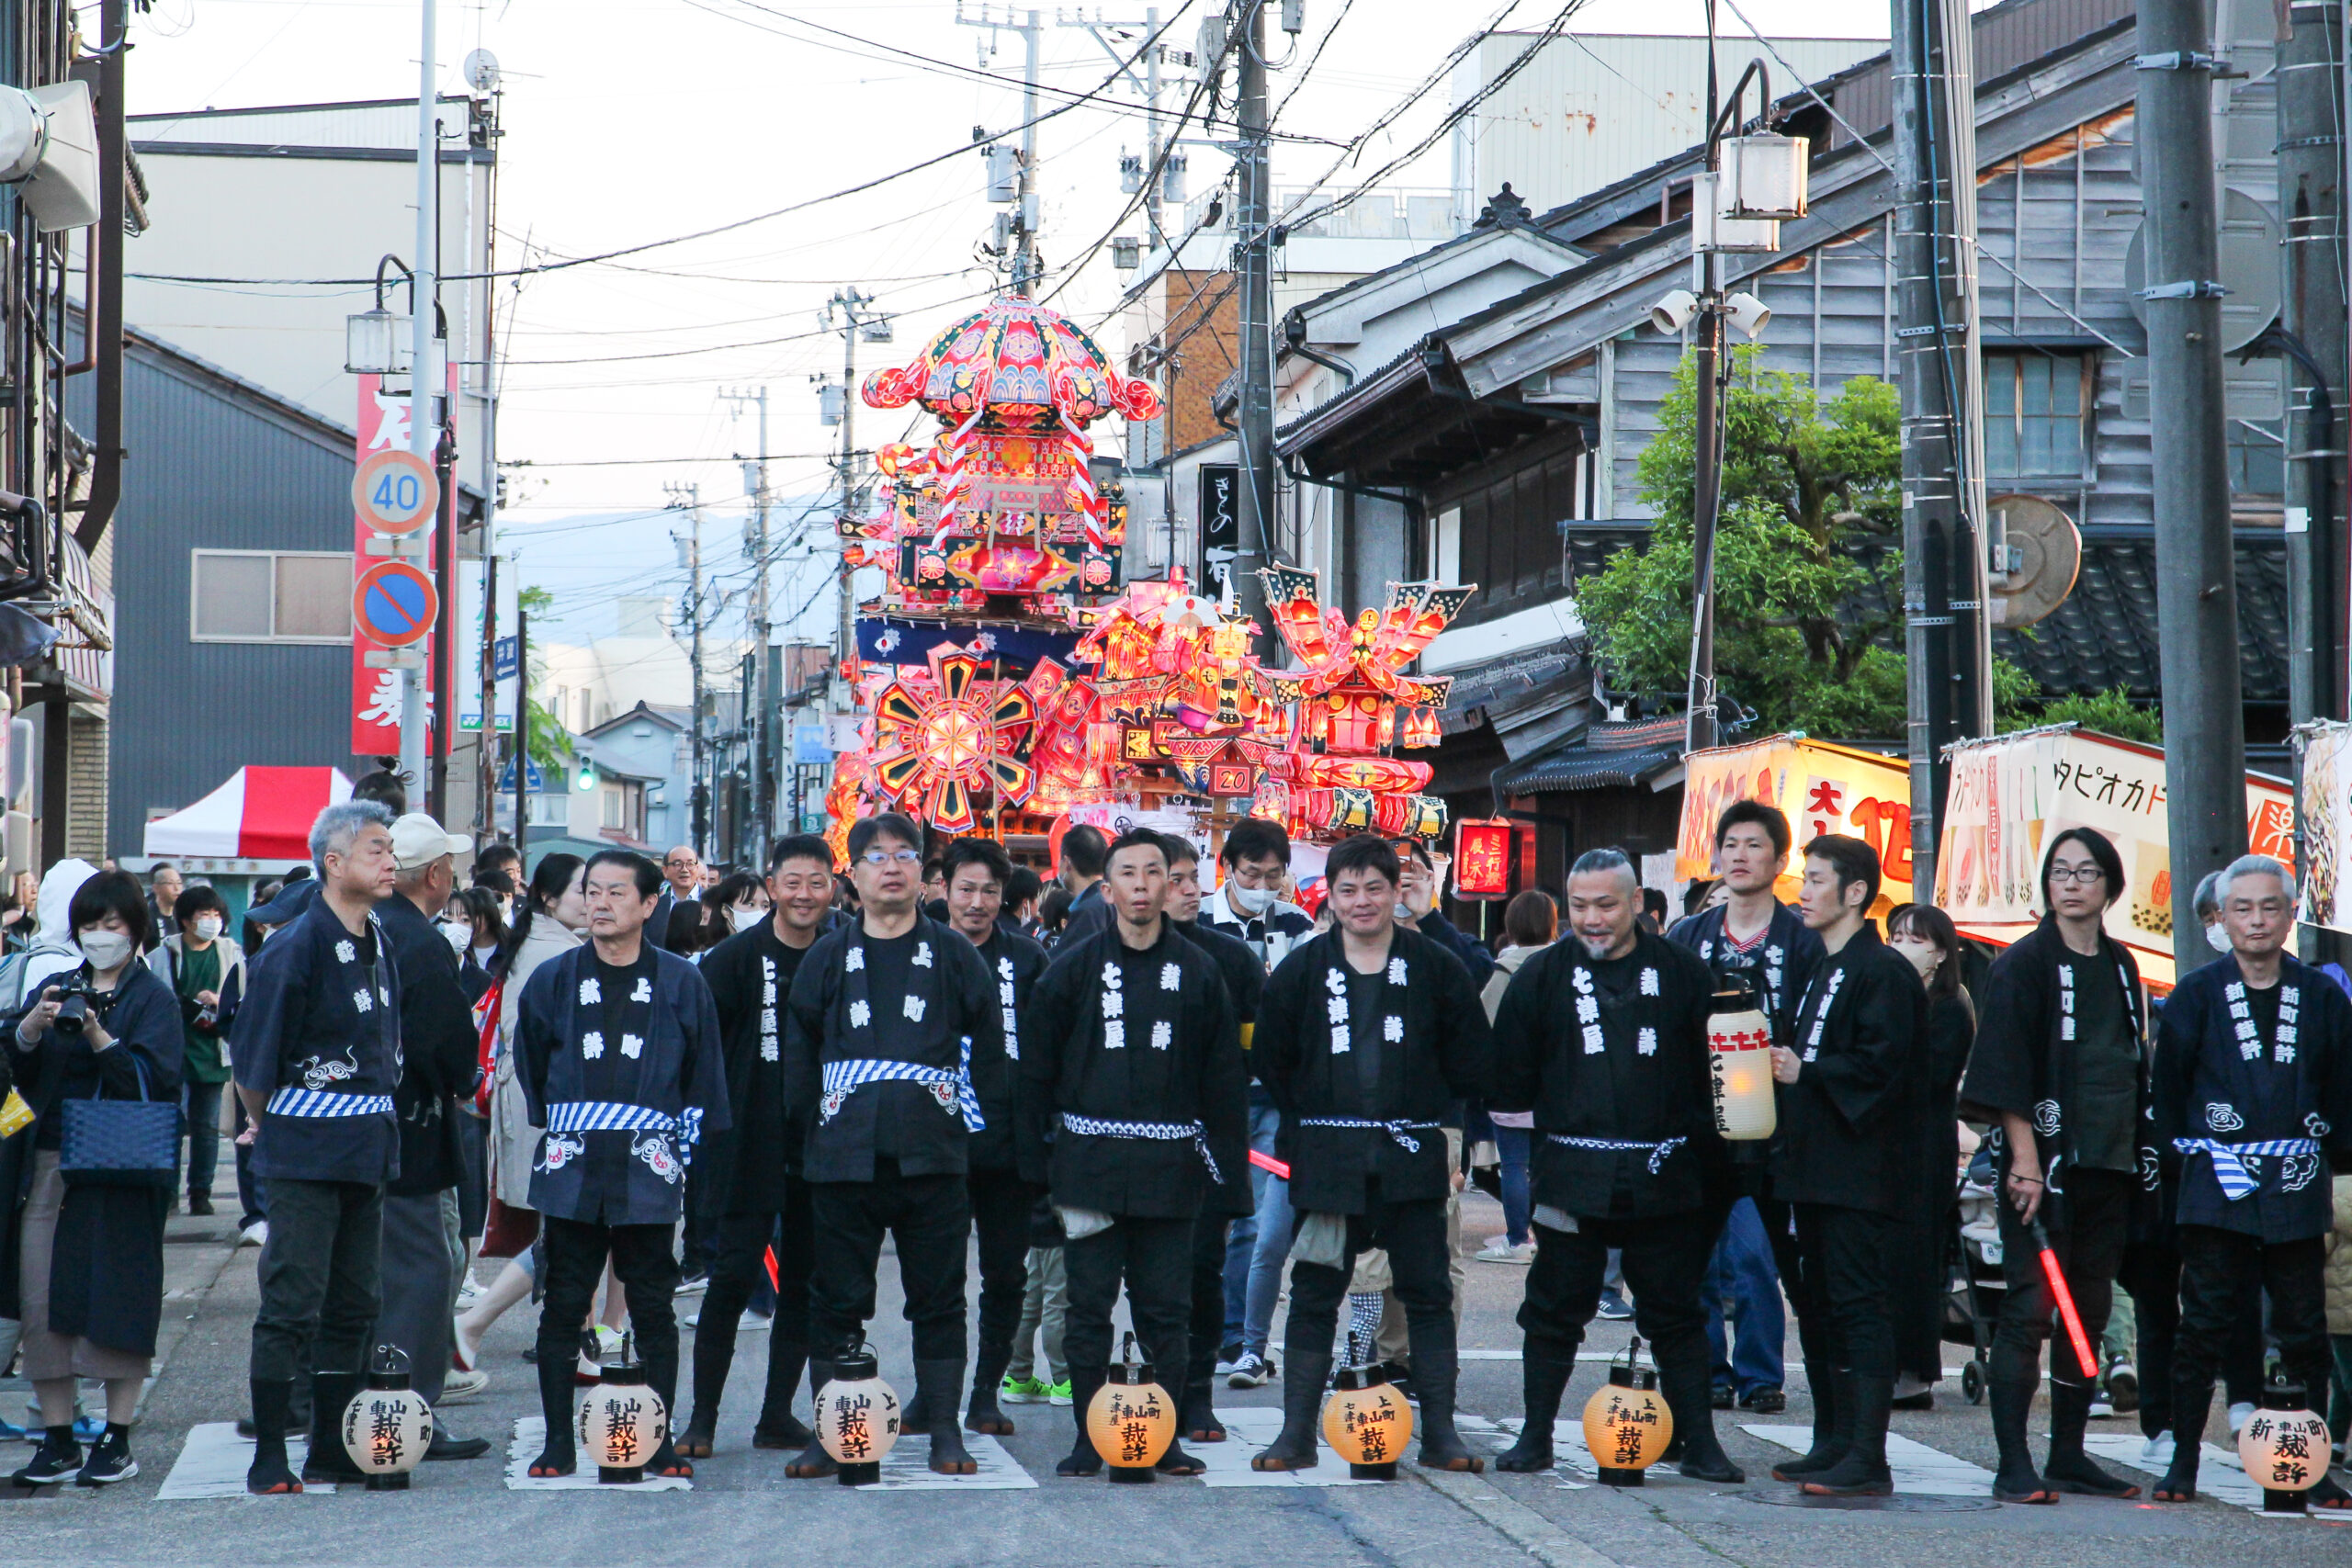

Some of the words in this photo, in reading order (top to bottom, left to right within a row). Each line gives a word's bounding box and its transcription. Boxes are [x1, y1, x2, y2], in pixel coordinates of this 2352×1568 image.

[373, 474, 418, 511] 40
[1345, 669, 1366, 686] 上
[1220, 771, 1245, 790] 20
[903, 942, 933, 1023] 上町
[620, 976, 653, 1060] 上町
[1102, 962, 1125, 1050] 七津屋
[1326, 967, 1351, 1055] 七津屋
[1572, 966, 1605, 1055] 七津屋
[2224, 980, 2263, 1062] 新町裁許
[2272, 985, 2301, 1064] 新町裁許
[416, 1399, 432, 1444] 上町
[651, 1397, 666, 1441] 上町
[881, 1392, 899, 1435] 上町
[1109, 1393, 1123, 1427] 七津屋
[1146, 1392, 1160, 1420] 上町
[1343, 1402, 1357, 1434] 七津屋
[1378, 1395, 1395, 1422] 上町
[1605, 1394, 1623, 1427] 七津屋
[1643, 1397, 1657, 1427] 上町
[371, 1413, 404, 1466] 裁許
[605, 1412, 639, 1463] 裁許
[837, 1409, 872, 1459] 裁許
[1121, 1421, 1148, 1462] 裁許
[1358, 1427, 1387, 1462] 裁許
[1614, 1426, 1642, 1465] 裁許
[2273, 1433, 2310, 1485] 裁許
